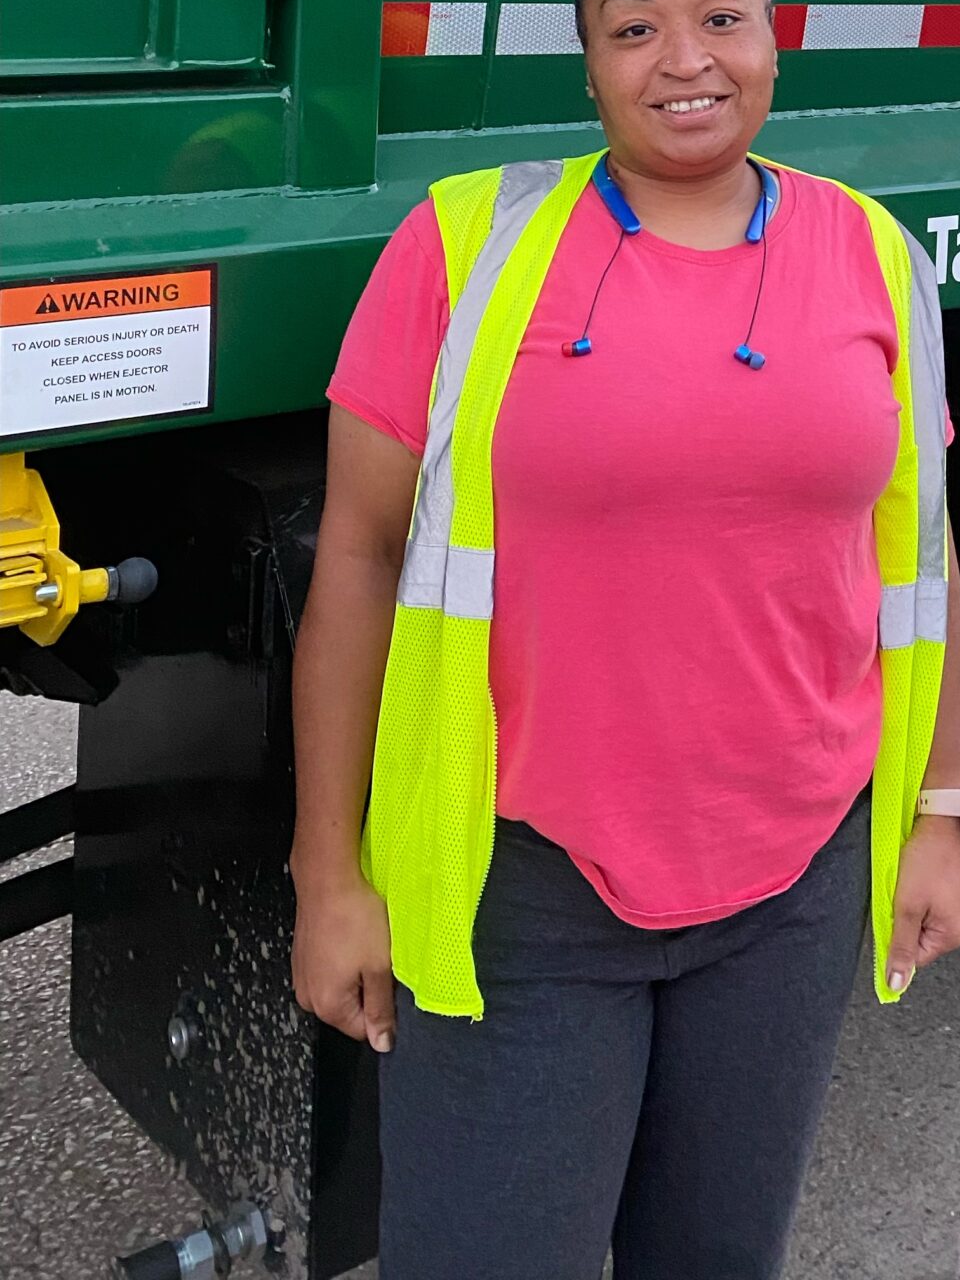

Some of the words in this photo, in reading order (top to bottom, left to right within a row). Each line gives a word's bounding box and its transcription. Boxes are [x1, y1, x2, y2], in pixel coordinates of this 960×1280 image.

[61, 283, 179, 312] WARNING
[12, 342, 27, 352] TO
[28, 338, 61, 350] AVOID
[63, 333, 110, 347] SERIOUS
[111, 328, 148, 342] INJURY
[149, 327, 165, 338] OR
[166, 323, 200, 336] DEATH
[50, 356, 80, 367] KEEP
[81, 350, 124, 364] ACCESS
[126, 346, 163, 360] DOORS
[42, 374, 87, 388] CLOSED
[88, 370, 120, 382] WHEN
[122, 364, 169, 378] EJECTOR
[53, 393, 89, 405] PANEL
[90, 390, 101, 401] IS
[102, 389, 114, 399] IN
[115, 383, 158, 398] MOTION.
